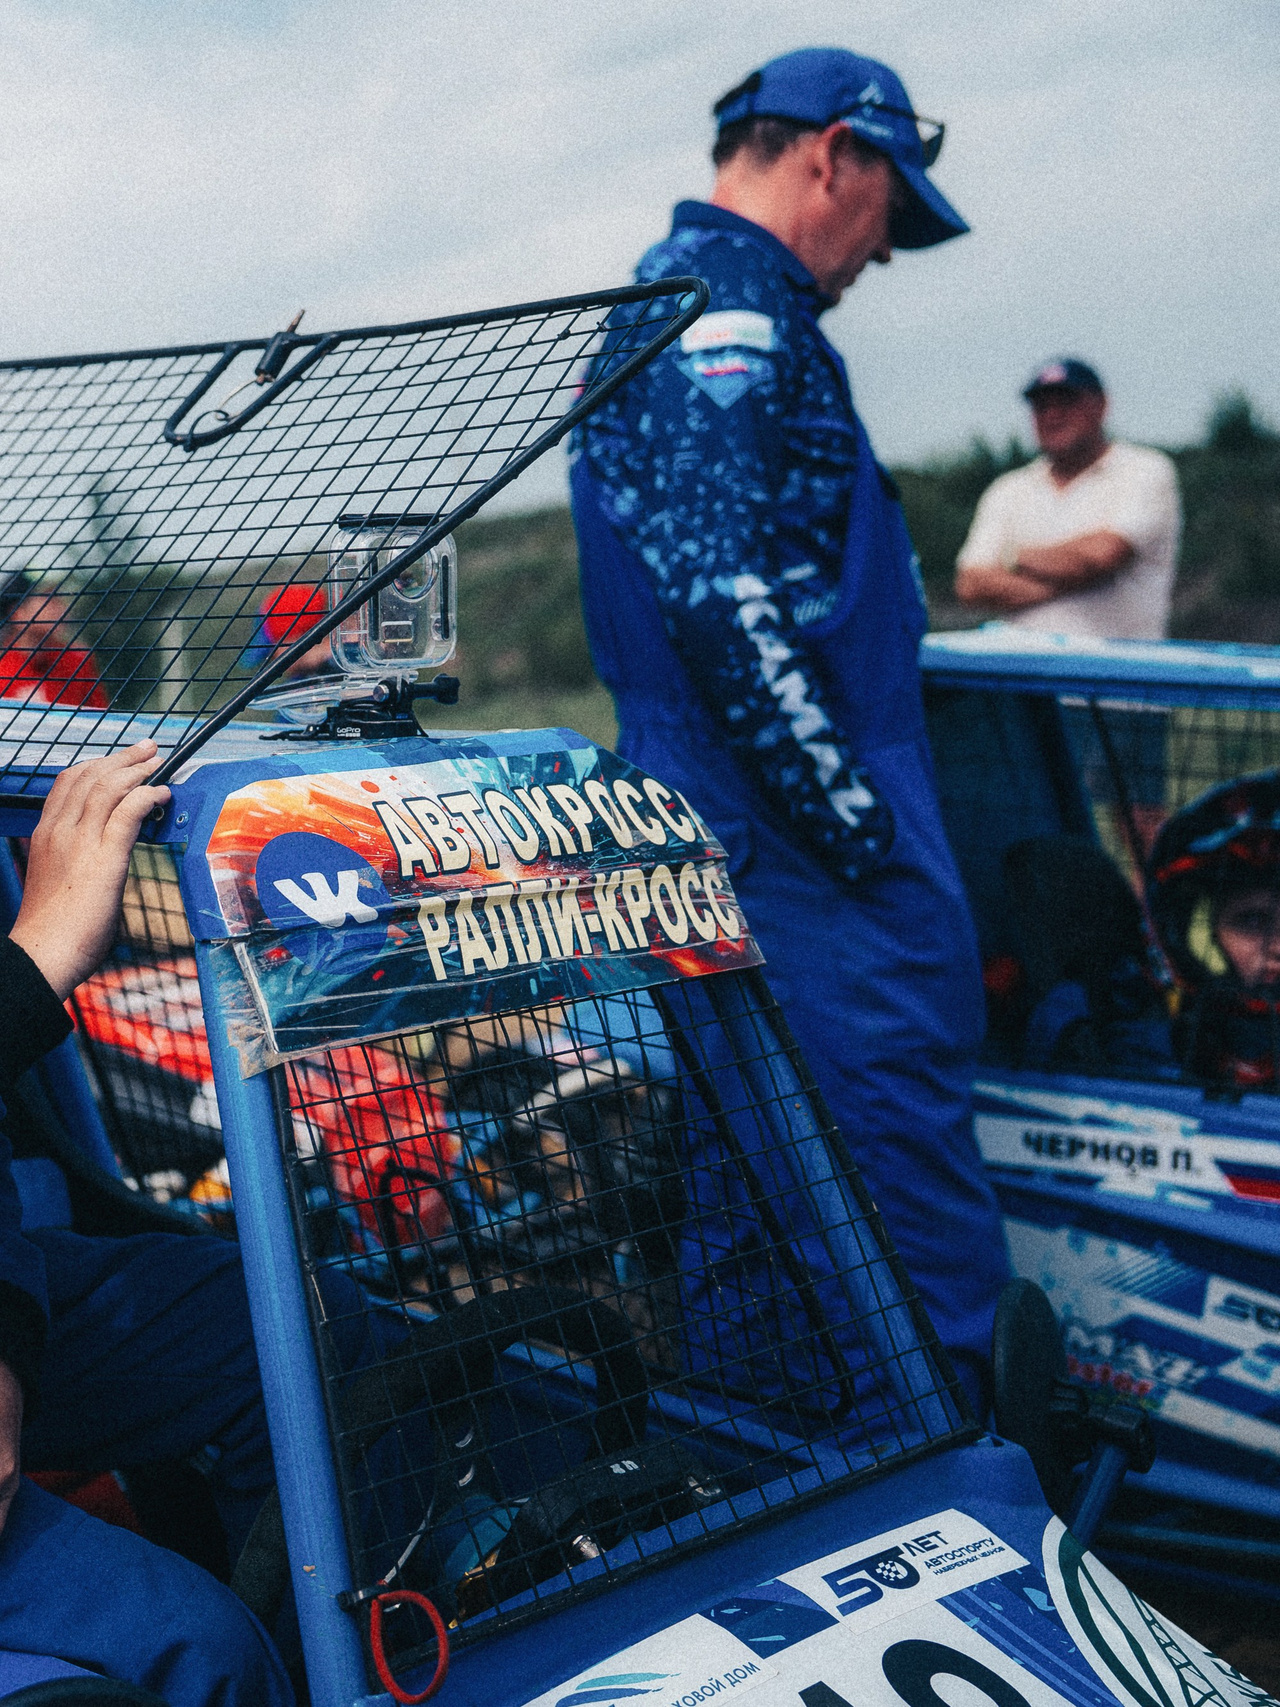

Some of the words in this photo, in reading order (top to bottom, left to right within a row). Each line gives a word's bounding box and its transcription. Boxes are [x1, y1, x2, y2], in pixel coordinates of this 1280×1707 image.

[336, 726, 361, 734] GoPro
[373, 777, 697, 878] АВТОКРОСС
[417, 862, 741, 981] РАЛЛИ-КРОСС
[1024, 1131, 1158, 1168] ЧЕРНОВ
[924, 1537, 995, 1569] АВТОСПОРТУ
[821, 1545, 921, 1618] 50
[901, 1530, 949, 1557] ЛЕТ
[723, 1661, 761, 1688] ДОМ
